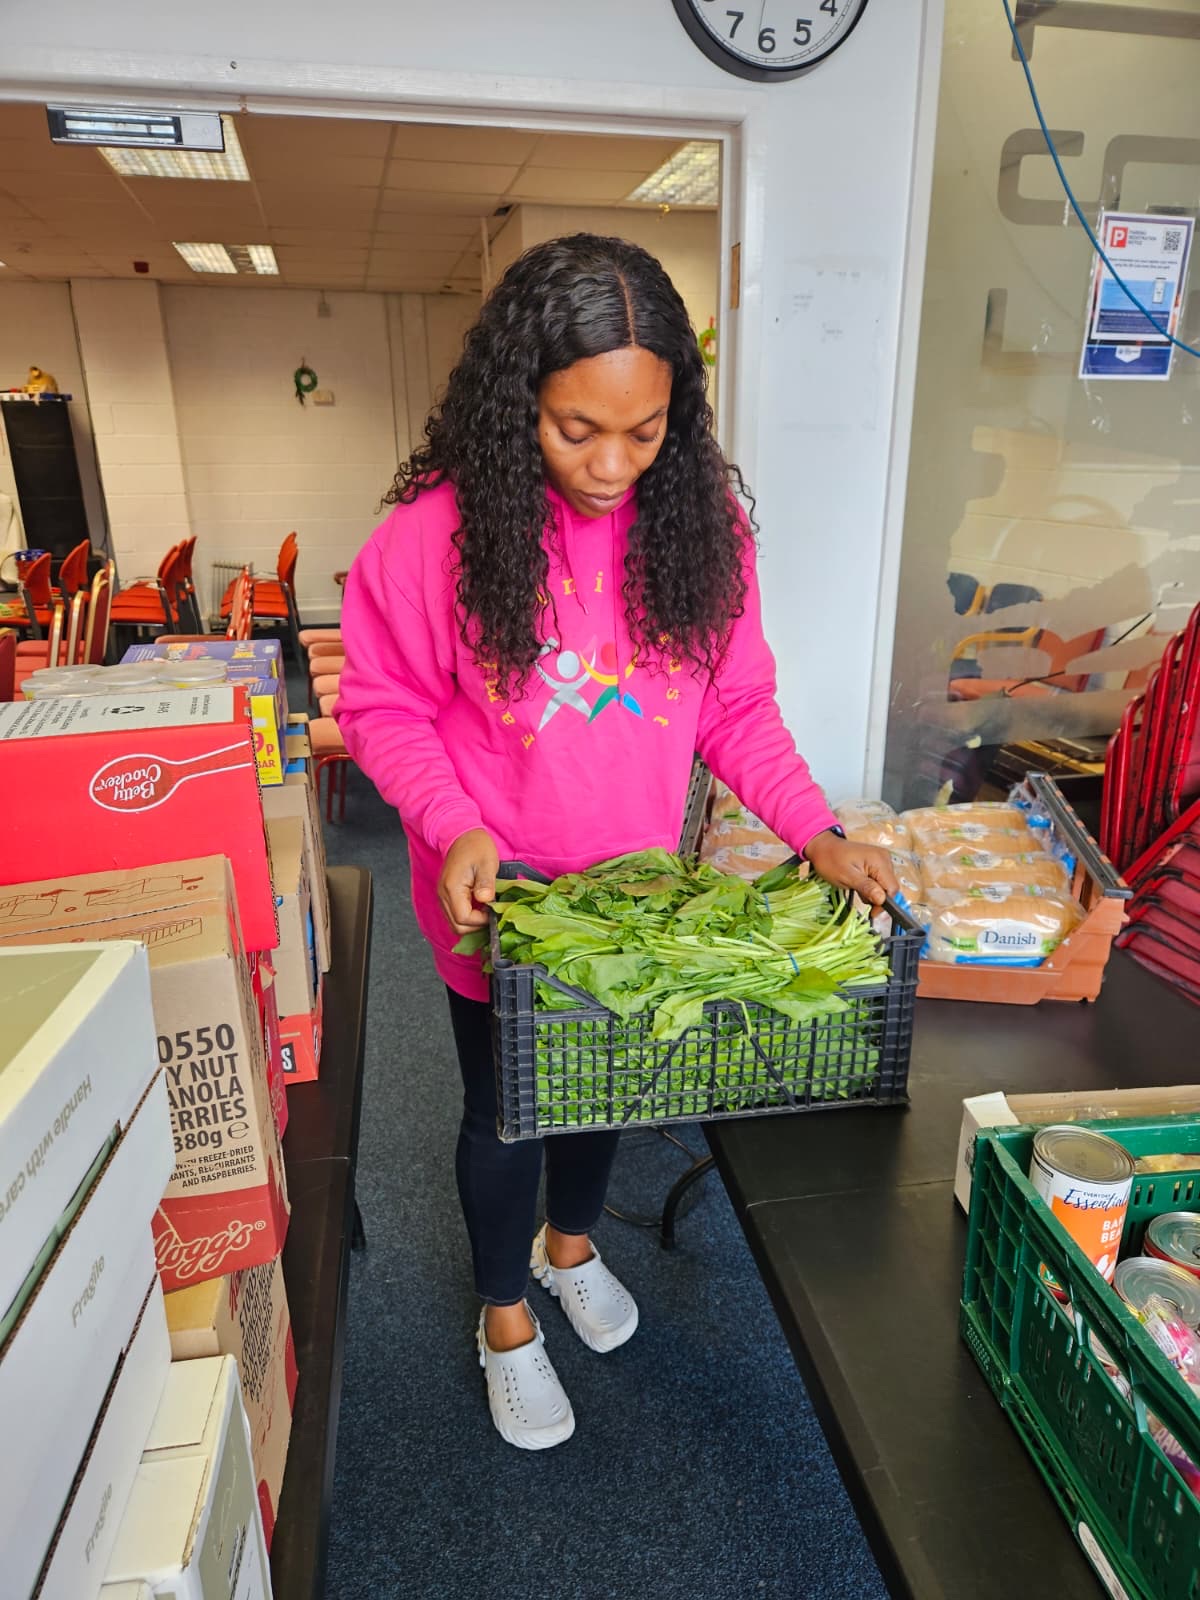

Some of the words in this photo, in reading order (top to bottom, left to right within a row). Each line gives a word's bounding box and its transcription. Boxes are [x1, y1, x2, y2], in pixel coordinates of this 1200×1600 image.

[819, 0, 838, 17] 4
[726, 10, 744, 38] 7
[793, 18, 812, 46] 5
[758, 27, 776, 53] 6
[113, 781, 155, 801] Betty
[983, 930, 1037, 946] Danish
[158, 1023, 235, 1064] 0550
[190, 1053, 239, 1081] NUT
[53, 1074, 92, 1136] Handle
[168, 1076, 245, 1110] ANOLA
[171, 1098, 247, 1133] ERRIES
[26, 1135, 53, 1178] with
[199, 1145, 254, 1166] FREEZE-DRIED
[168, 1166, 197, 1183] RANTS,
[182, 1176, 199, 1188] AND
[71, 1256, 105, 1328] Fragile
